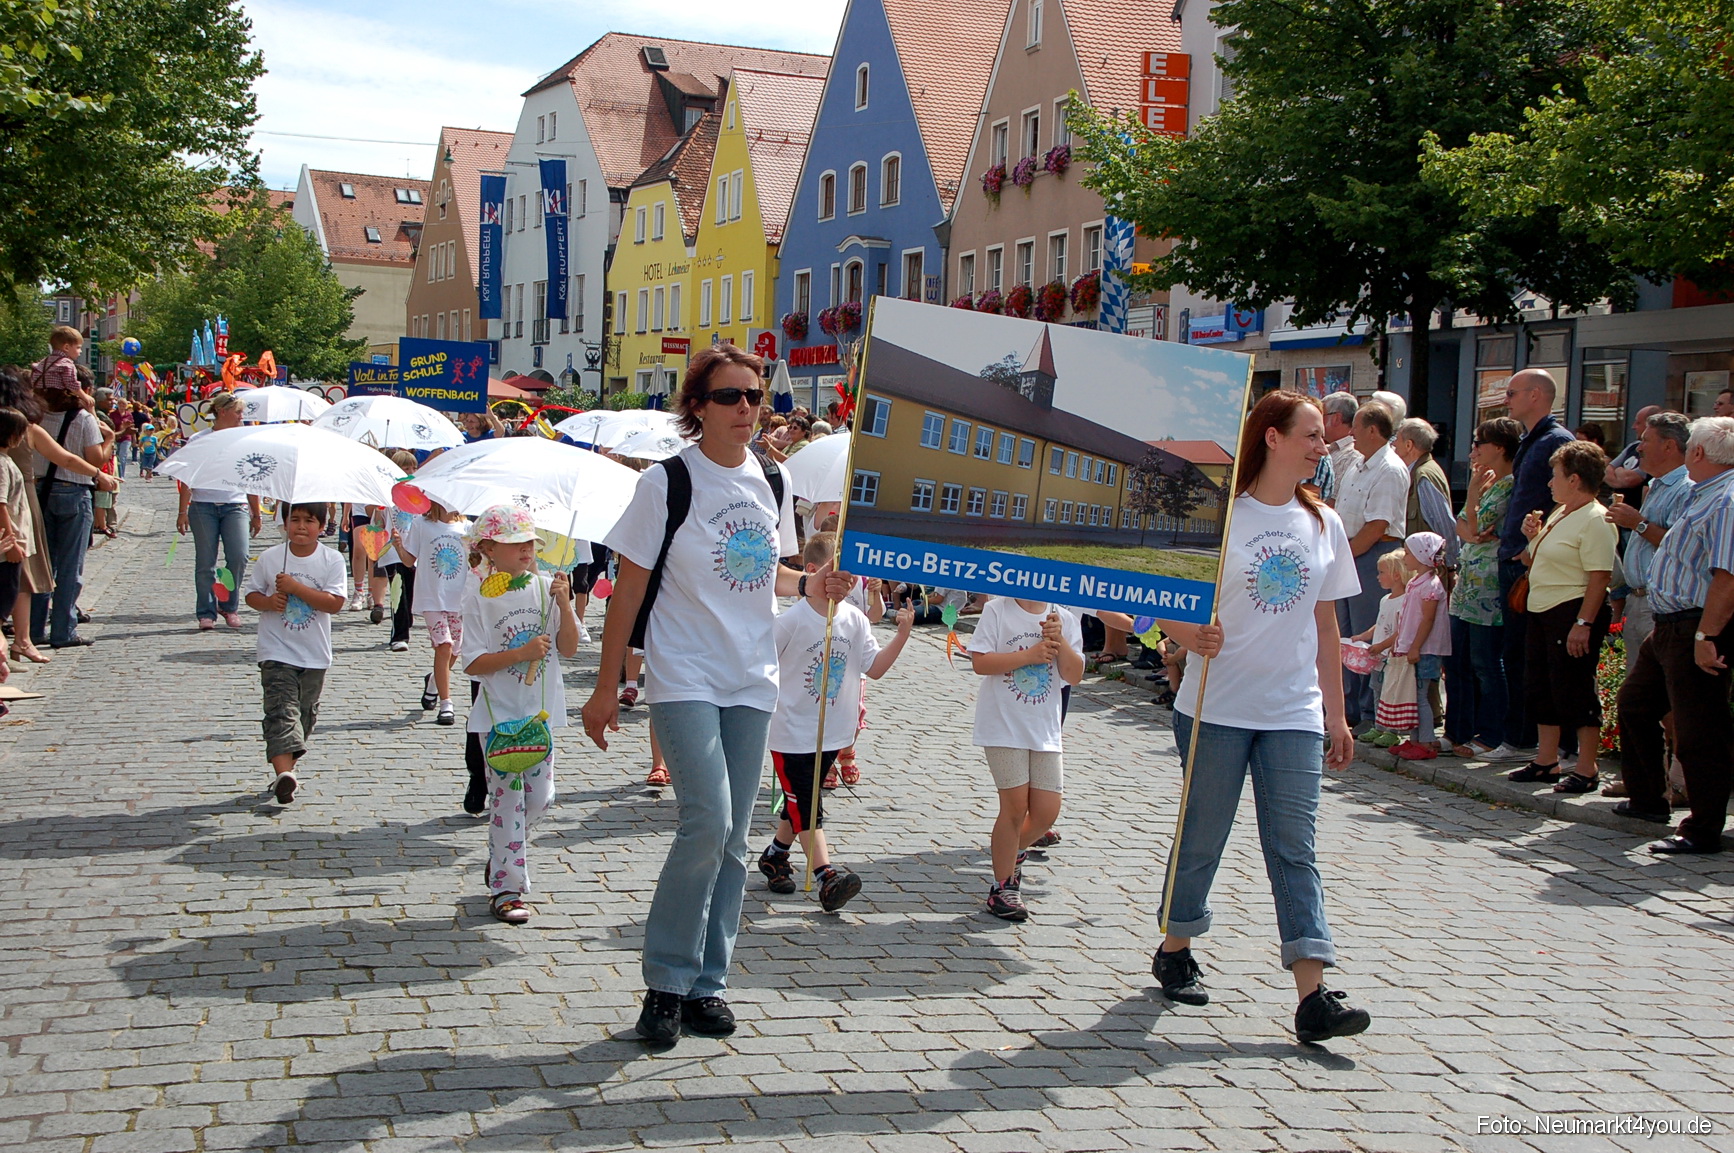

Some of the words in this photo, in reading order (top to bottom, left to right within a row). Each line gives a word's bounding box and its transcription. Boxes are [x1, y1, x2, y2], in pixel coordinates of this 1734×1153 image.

[556, 220, 566, 276] RUPPERT
[643, 263, 663, 281] HOTEL
[558, 278, 567, 300] K&L
[410, 352, 448, 368] GRUND
[353, 368, 375, 382] Voll
[377, 369, 388, 380] in
[388, 368, 399, 380] Fo
[403, 364, 444, 381] SCHULE
[405, 387, 479, 401] WOFFENBACH
[1245, 530, 1310, 554] Theo-Betz-Schule
[854, 541, 1070, 594] THEO-BETZ-SCHULE
[1078, 575, 1202, 613] NEUMARKT
